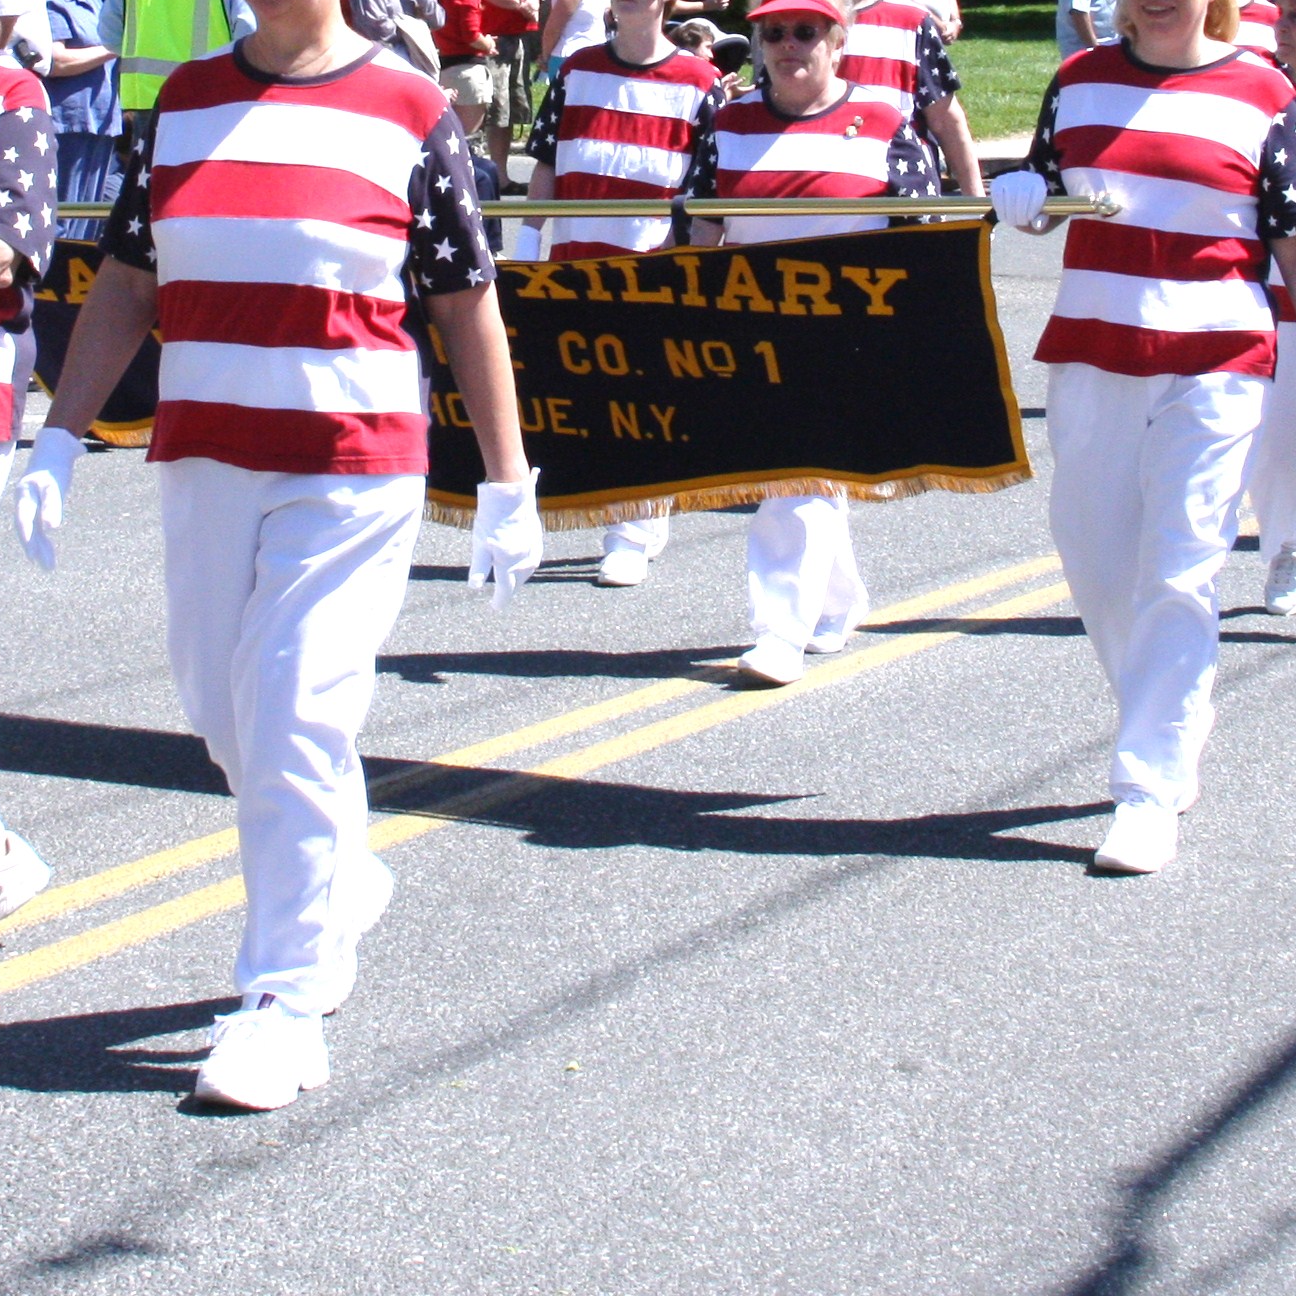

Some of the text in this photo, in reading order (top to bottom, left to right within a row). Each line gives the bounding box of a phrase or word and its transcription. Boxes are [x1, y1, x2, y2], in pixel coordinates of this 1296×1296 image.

[503, 254, 908, 316] XILIARY
[558, 330, 644, 376] CO.
[754, 340, 783, 384] 1
[608, 400, 690, 442] N.Y.
